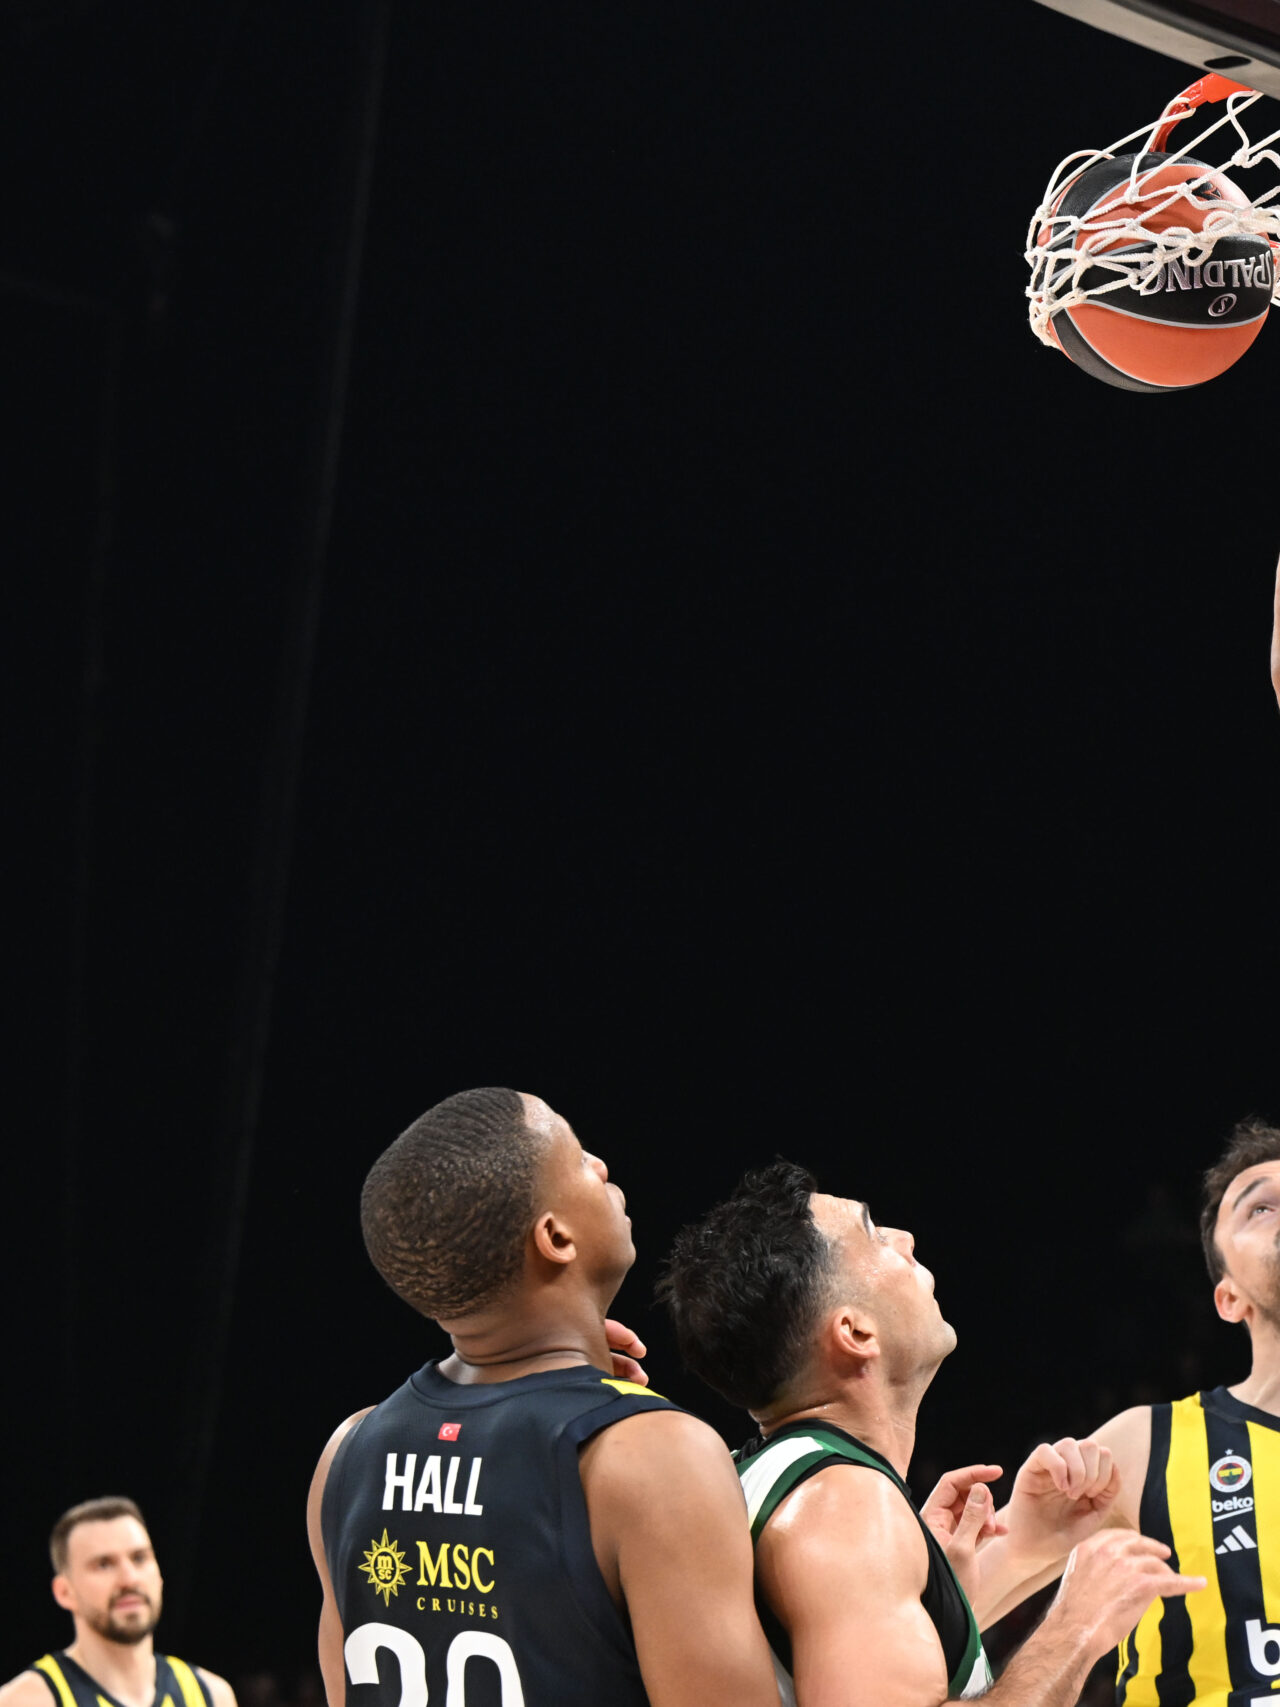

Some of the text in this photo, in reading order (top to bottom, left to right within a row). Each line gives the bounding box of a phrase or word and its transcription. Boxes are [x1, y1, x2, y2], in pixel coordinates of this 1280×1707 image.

[382, 1452, 483, 1516] HALL
[1212, 1496, 1254, 1513] beko
[415, 1540, 495, 1594] MSC
[416, 1597, 498, 1619] CRUISES
